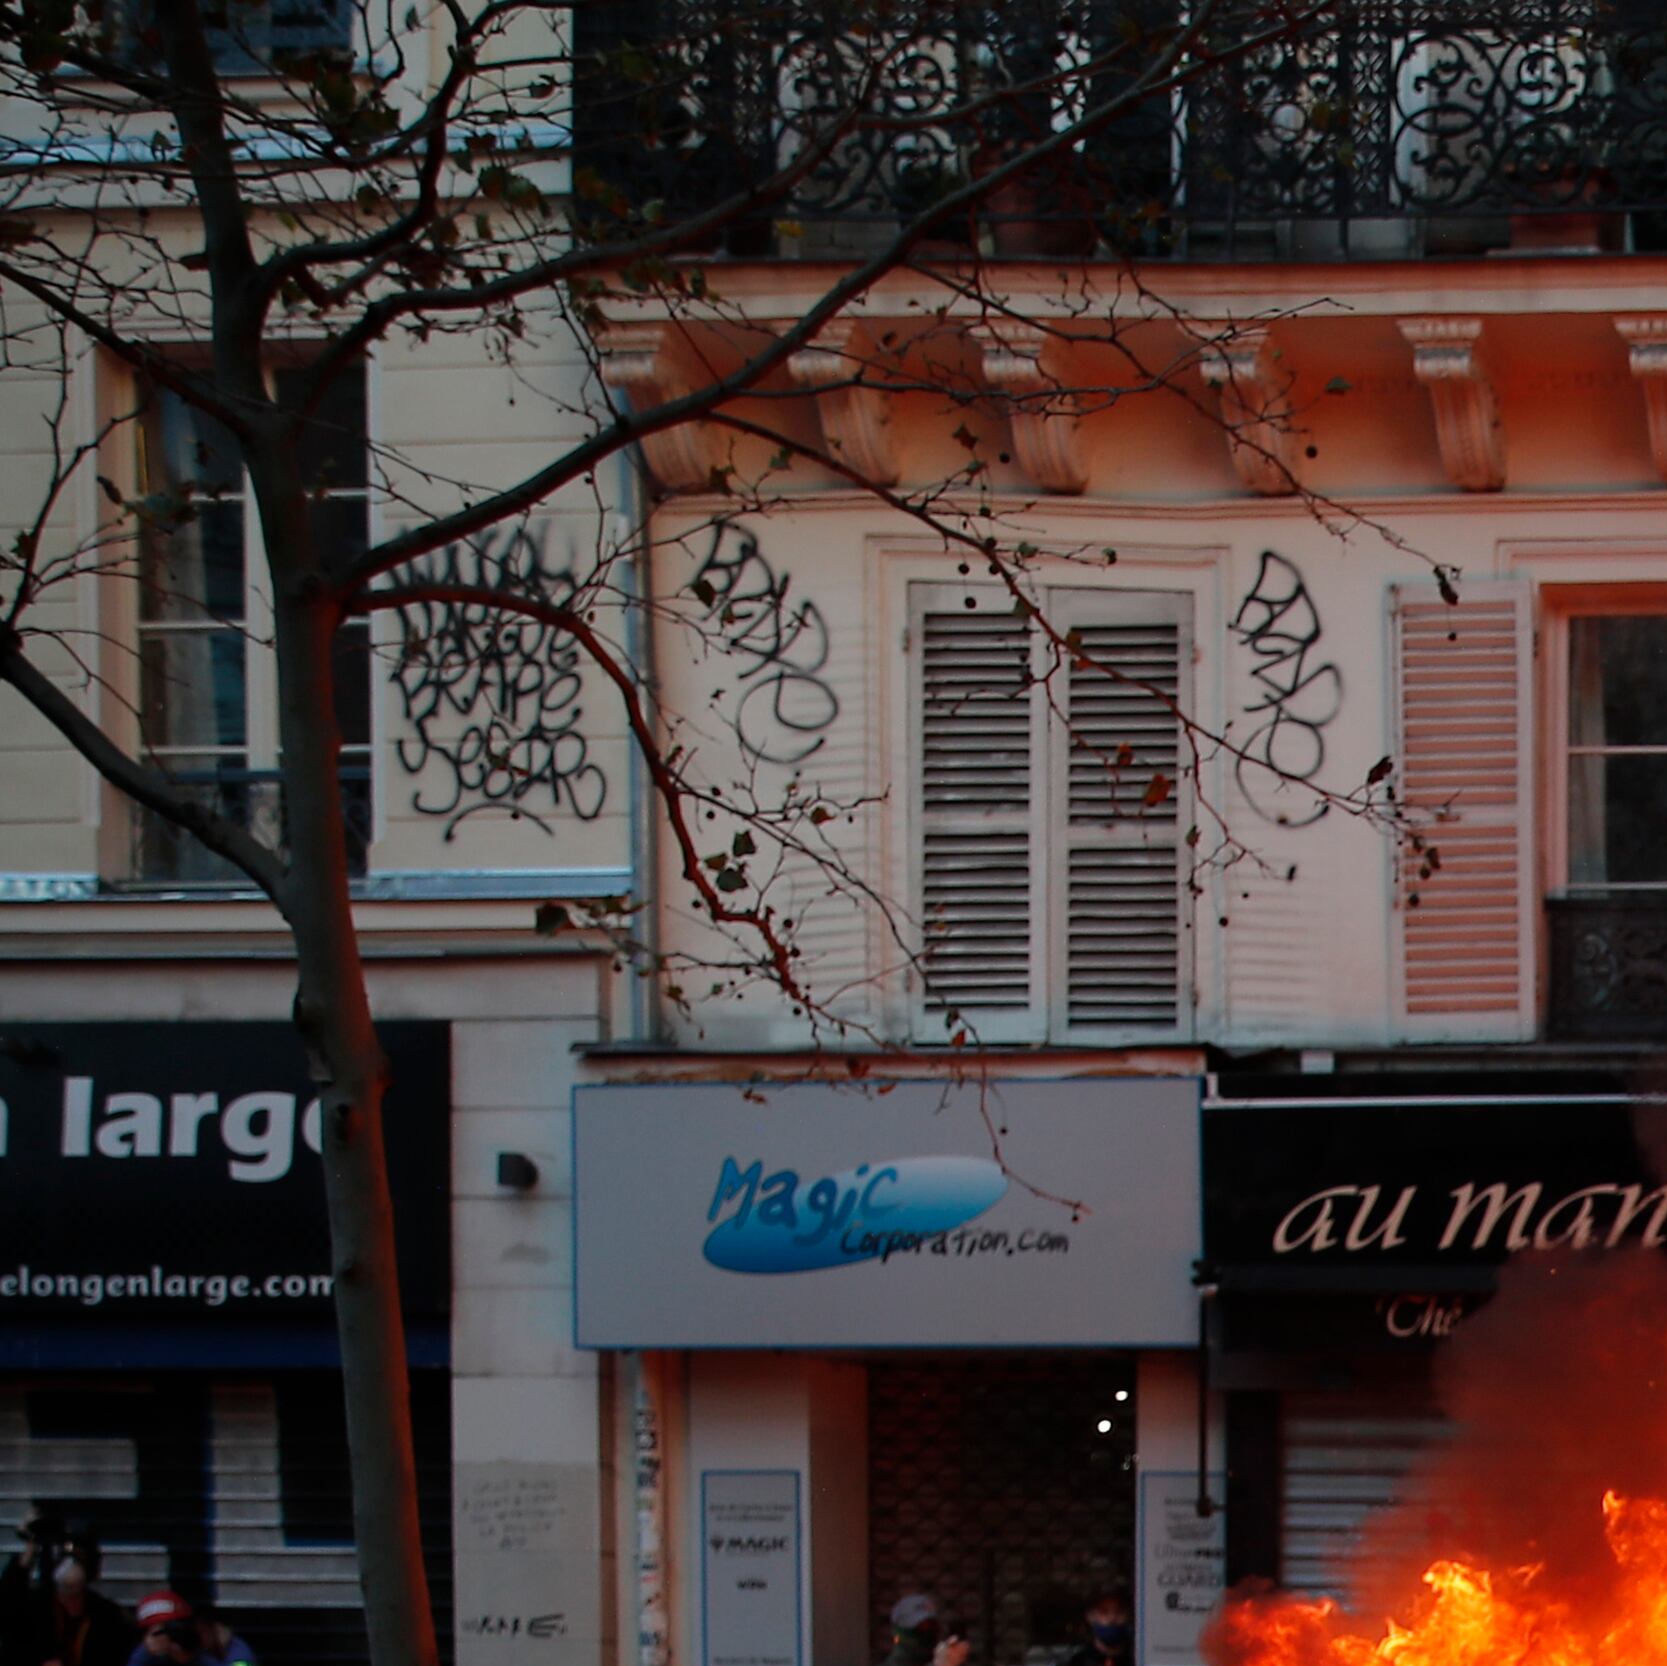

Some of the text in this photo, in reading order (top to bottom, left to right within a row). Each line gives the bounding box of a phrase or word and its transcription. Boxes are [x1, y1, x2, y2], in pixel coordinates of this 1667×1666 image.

[61, 1076, 324, 1182] larg
[707, 1156, 901, 1246] Magic
[1271, 1184, 1418, 1254] au
